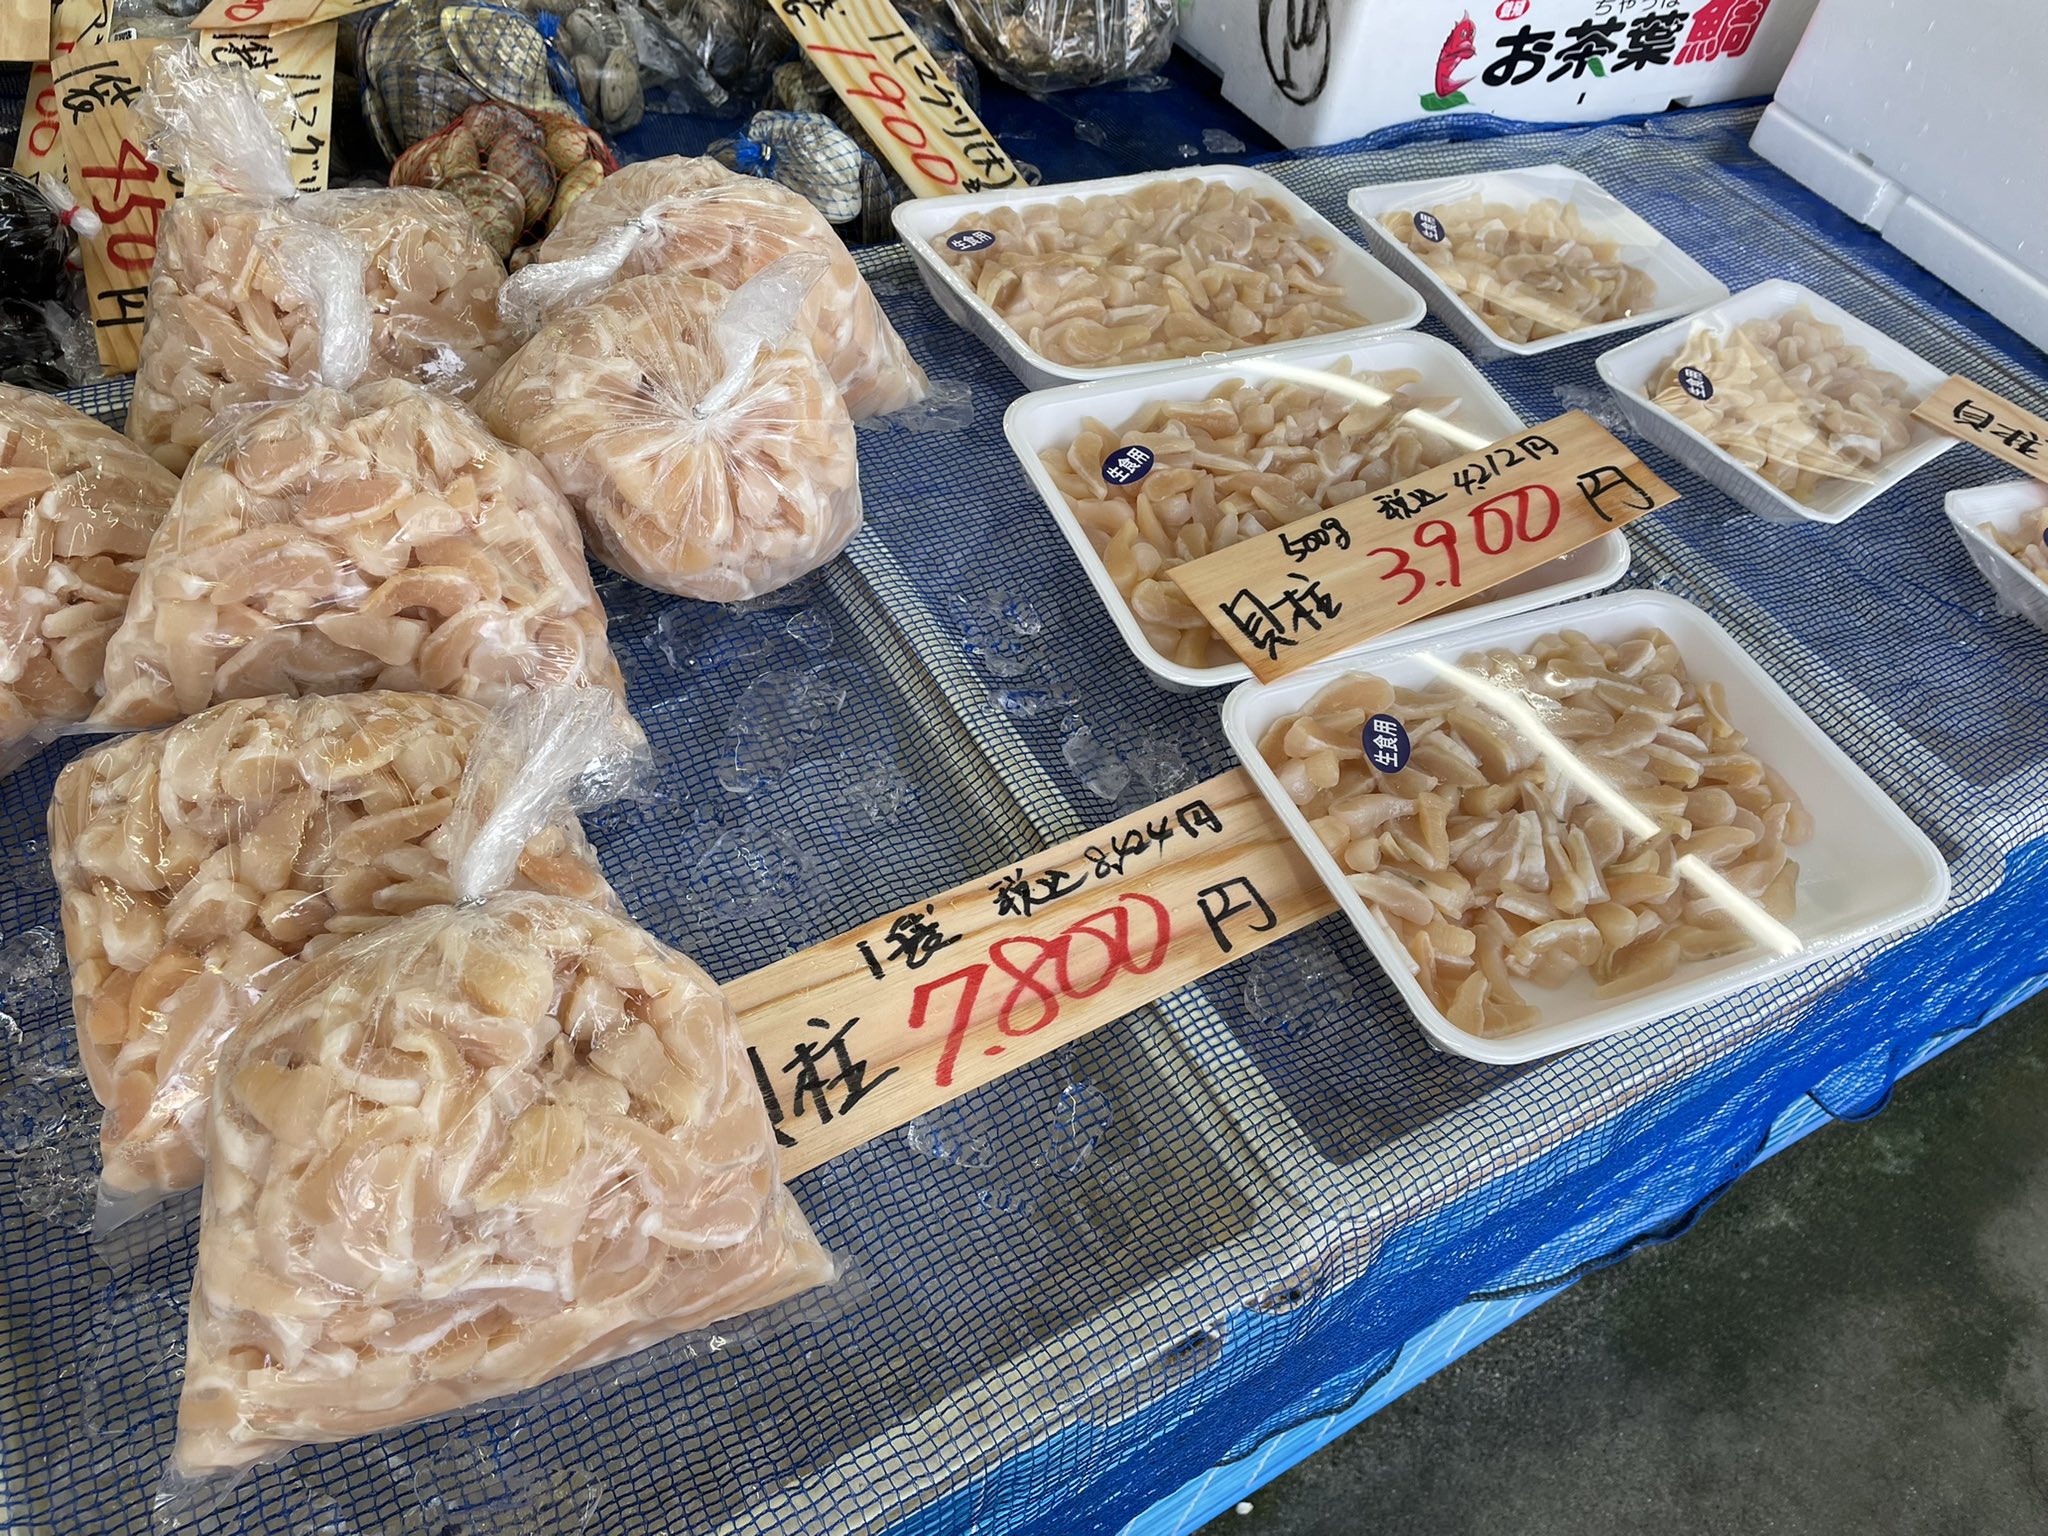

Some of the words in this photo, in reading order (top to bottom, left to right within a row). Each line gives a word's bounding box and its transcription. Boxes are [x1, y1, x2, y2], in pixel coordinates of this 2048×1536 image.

[806, 44, 959, 186] 1900
[1105, 446, 1151, 483] 生食用
[1277, 517, 1352, 563] 500g
[1218, 572, 1343, 661] 貝柱
[1371, 718, 1399, 768] 生食用
